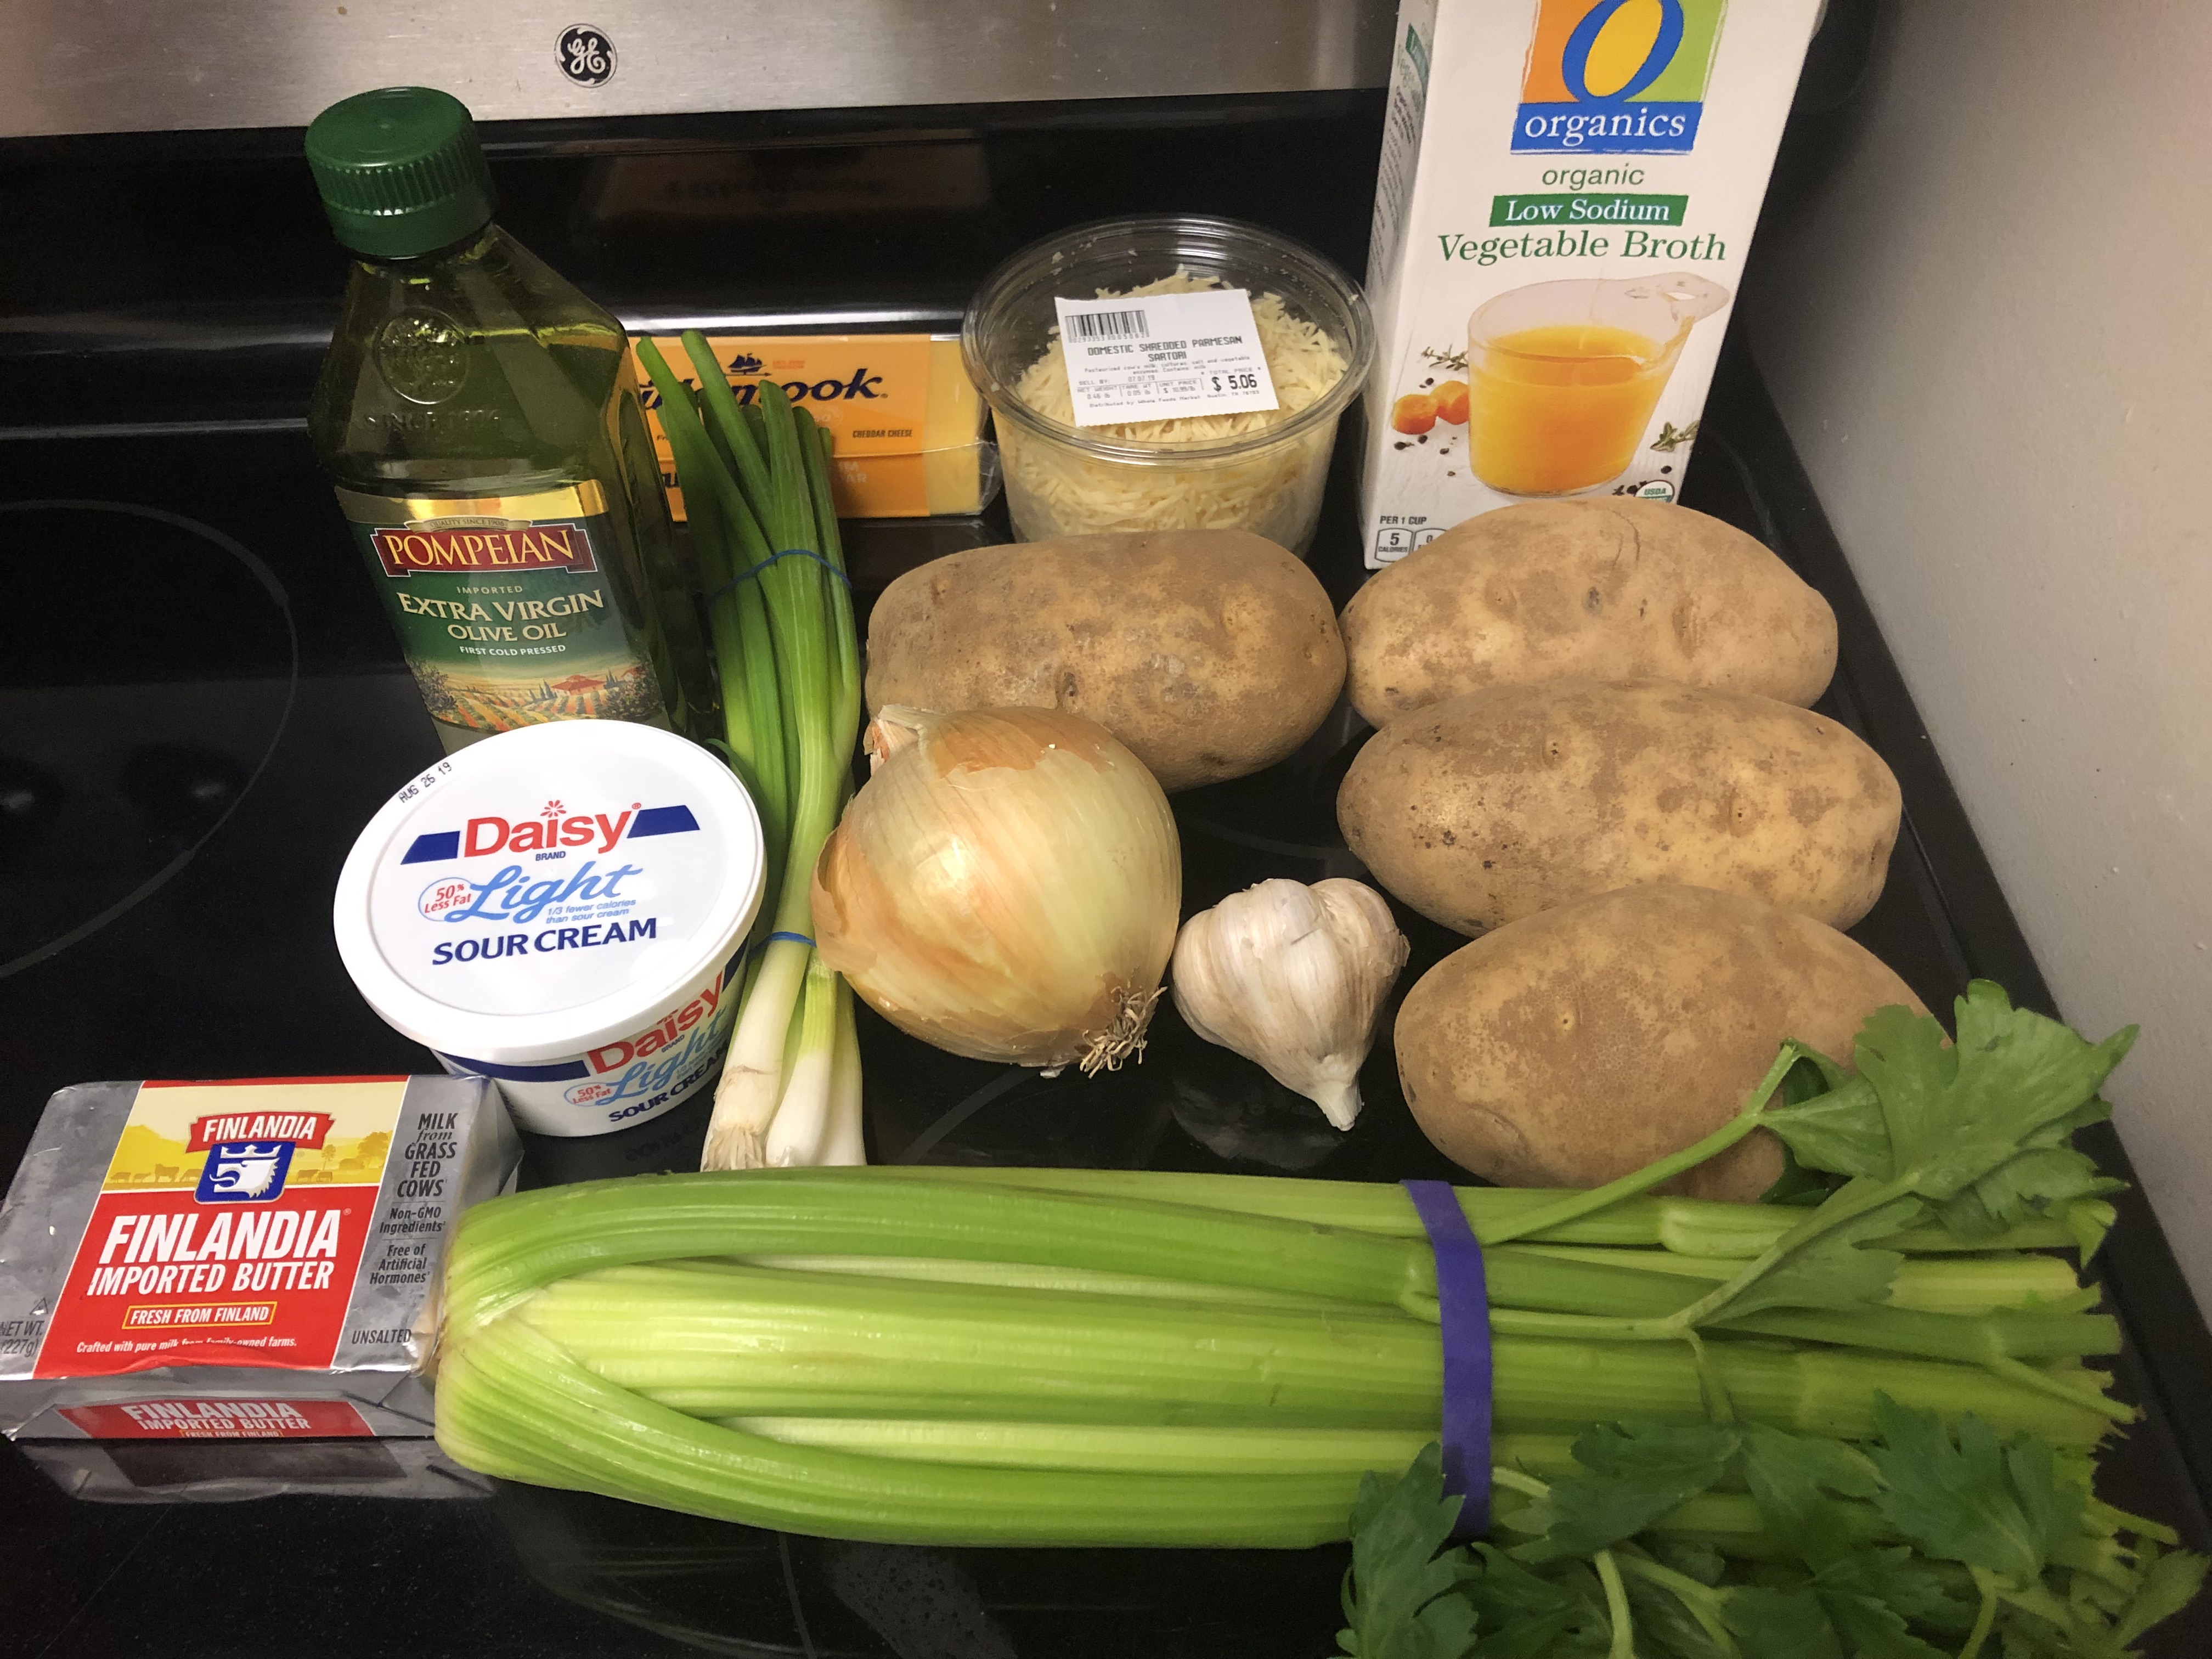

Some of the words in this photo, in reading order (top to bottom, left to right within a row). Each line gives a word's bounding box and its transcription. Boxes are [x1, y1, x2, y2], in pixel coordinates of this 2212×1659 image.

[1525, 106, 1686, 147] organics
[1542, 163, 1645, 191] organic
[1507, 200, 1564, 222] Low
[1569, 198, 1669, 221] Sodium
[1438, 230, 1609, 267] Vegetable
[1620, 230, 1728, 261] Broth
[1087, 345, 1133, 357] DOMESTIC
[1139, 340, 1187, 352] SHREDDED
[1192, 336, 1243, 347] PARMESAN
[1148, 351, 1187, 362] SARTORI
[1211, 376, 1222, 392] $
[1228, 374, 1257, 390] 5.06
[853, 430, 886, 438] CHEDDAR
[887, 429, 913, 438] CHEESE
[430, 520, 461, 528] QUALITY
[1379, 516, 1398, 524] PER
[1408, 516, 1427, 525] CUP
[382, 529, 574, 566] POMPEIAN
[1390, 533, 1400, 546] 5
[456, 585, 523, 595] IMPORTED
[397, 592, 493, 622] EXTRA
[492, 589, 604, 622] VIRGIN
[447, 624, 518, 642] OLIVE
[522, 623, 567, 641] OIL
[459, 646, 487, 655] FIRST
[489, 646, 518, 656] COLD
[520, 645, 566, 655] PRESSED
[398, 785, 419, 803] AUG
[420, 774, 436, 788] 26
[438, 761, 452, 775] 19
[464, 804, 633, 857] Daisy
[535, 850, 566, 861] BRAND
[435, 884, 465, 902] 50%
[444, 860, 644, 924] Light
[424, 900, 449, 914] Less
[453, 893, 471, 907] Fat
[548, 906, 563, 916] 1/3
[566, 904, 594, 914] fewer
[596, 898, 636, 911] calories
[546, 915, 568, 924] than
[571, 913, 595, 922] sour
[596, 908, 630, 918] cream
[432, 933, 529, 966] SOUR
[533, 917, 657, 952] CREAM
[587, 970, 723, 1074] Daisy
[661, 1034, 685, 1053] BRAND
[595, 1004, 727, 1106] Light
[572, 1096, 594, 1104] Less
[595, 1088, 612, 1098] Fat
[577, 1084, 602, 1098] 50%
[608, 1091, 669, 1122] SOUR
[202, 1115, 318, 1142] FINLANDIA
[417, 1113, 459, 1130] MILK
[415, 1128, 453, 1144] from
[404, 1142, 458, 1160] GRASS
[410, 1160, 441, 1178] FED
[389, 1206, 442, 1220] Non-GMO
[99, 1210, 341, 1265] FINLANDIA
[387, 1245, 410, 1257] Free
[413, 1243, 426, 1256] of
[378, 1257, 427, 1271] Artificial
[86, 1263, 226, 1296] IMPORTED
[232, 1261, 335, 1292] BUTTER
[130, 1308, 170, 1325] FRESH
[174, 1307, 210, 1324] FROM
[214, 1306, 269, 1323] FINLAND
[24, 1320, 45, 1336] WT.
[351, 1328, 412, 1345] UNSALTED
[76, 1341, 113, 1353] Crafted
[114, 1340, 134, 1352] with
[134, 1342, 157, 1353] pure
[159, 1339, 179, 1350] milk
[268, 1336, 297, 1347] farms.
[121, 1402, 304, 1420] FINLANDIA
[138, 1418, 235, 1430] IMPORTED
[239, 1417, 312, 1430] BUTTER
